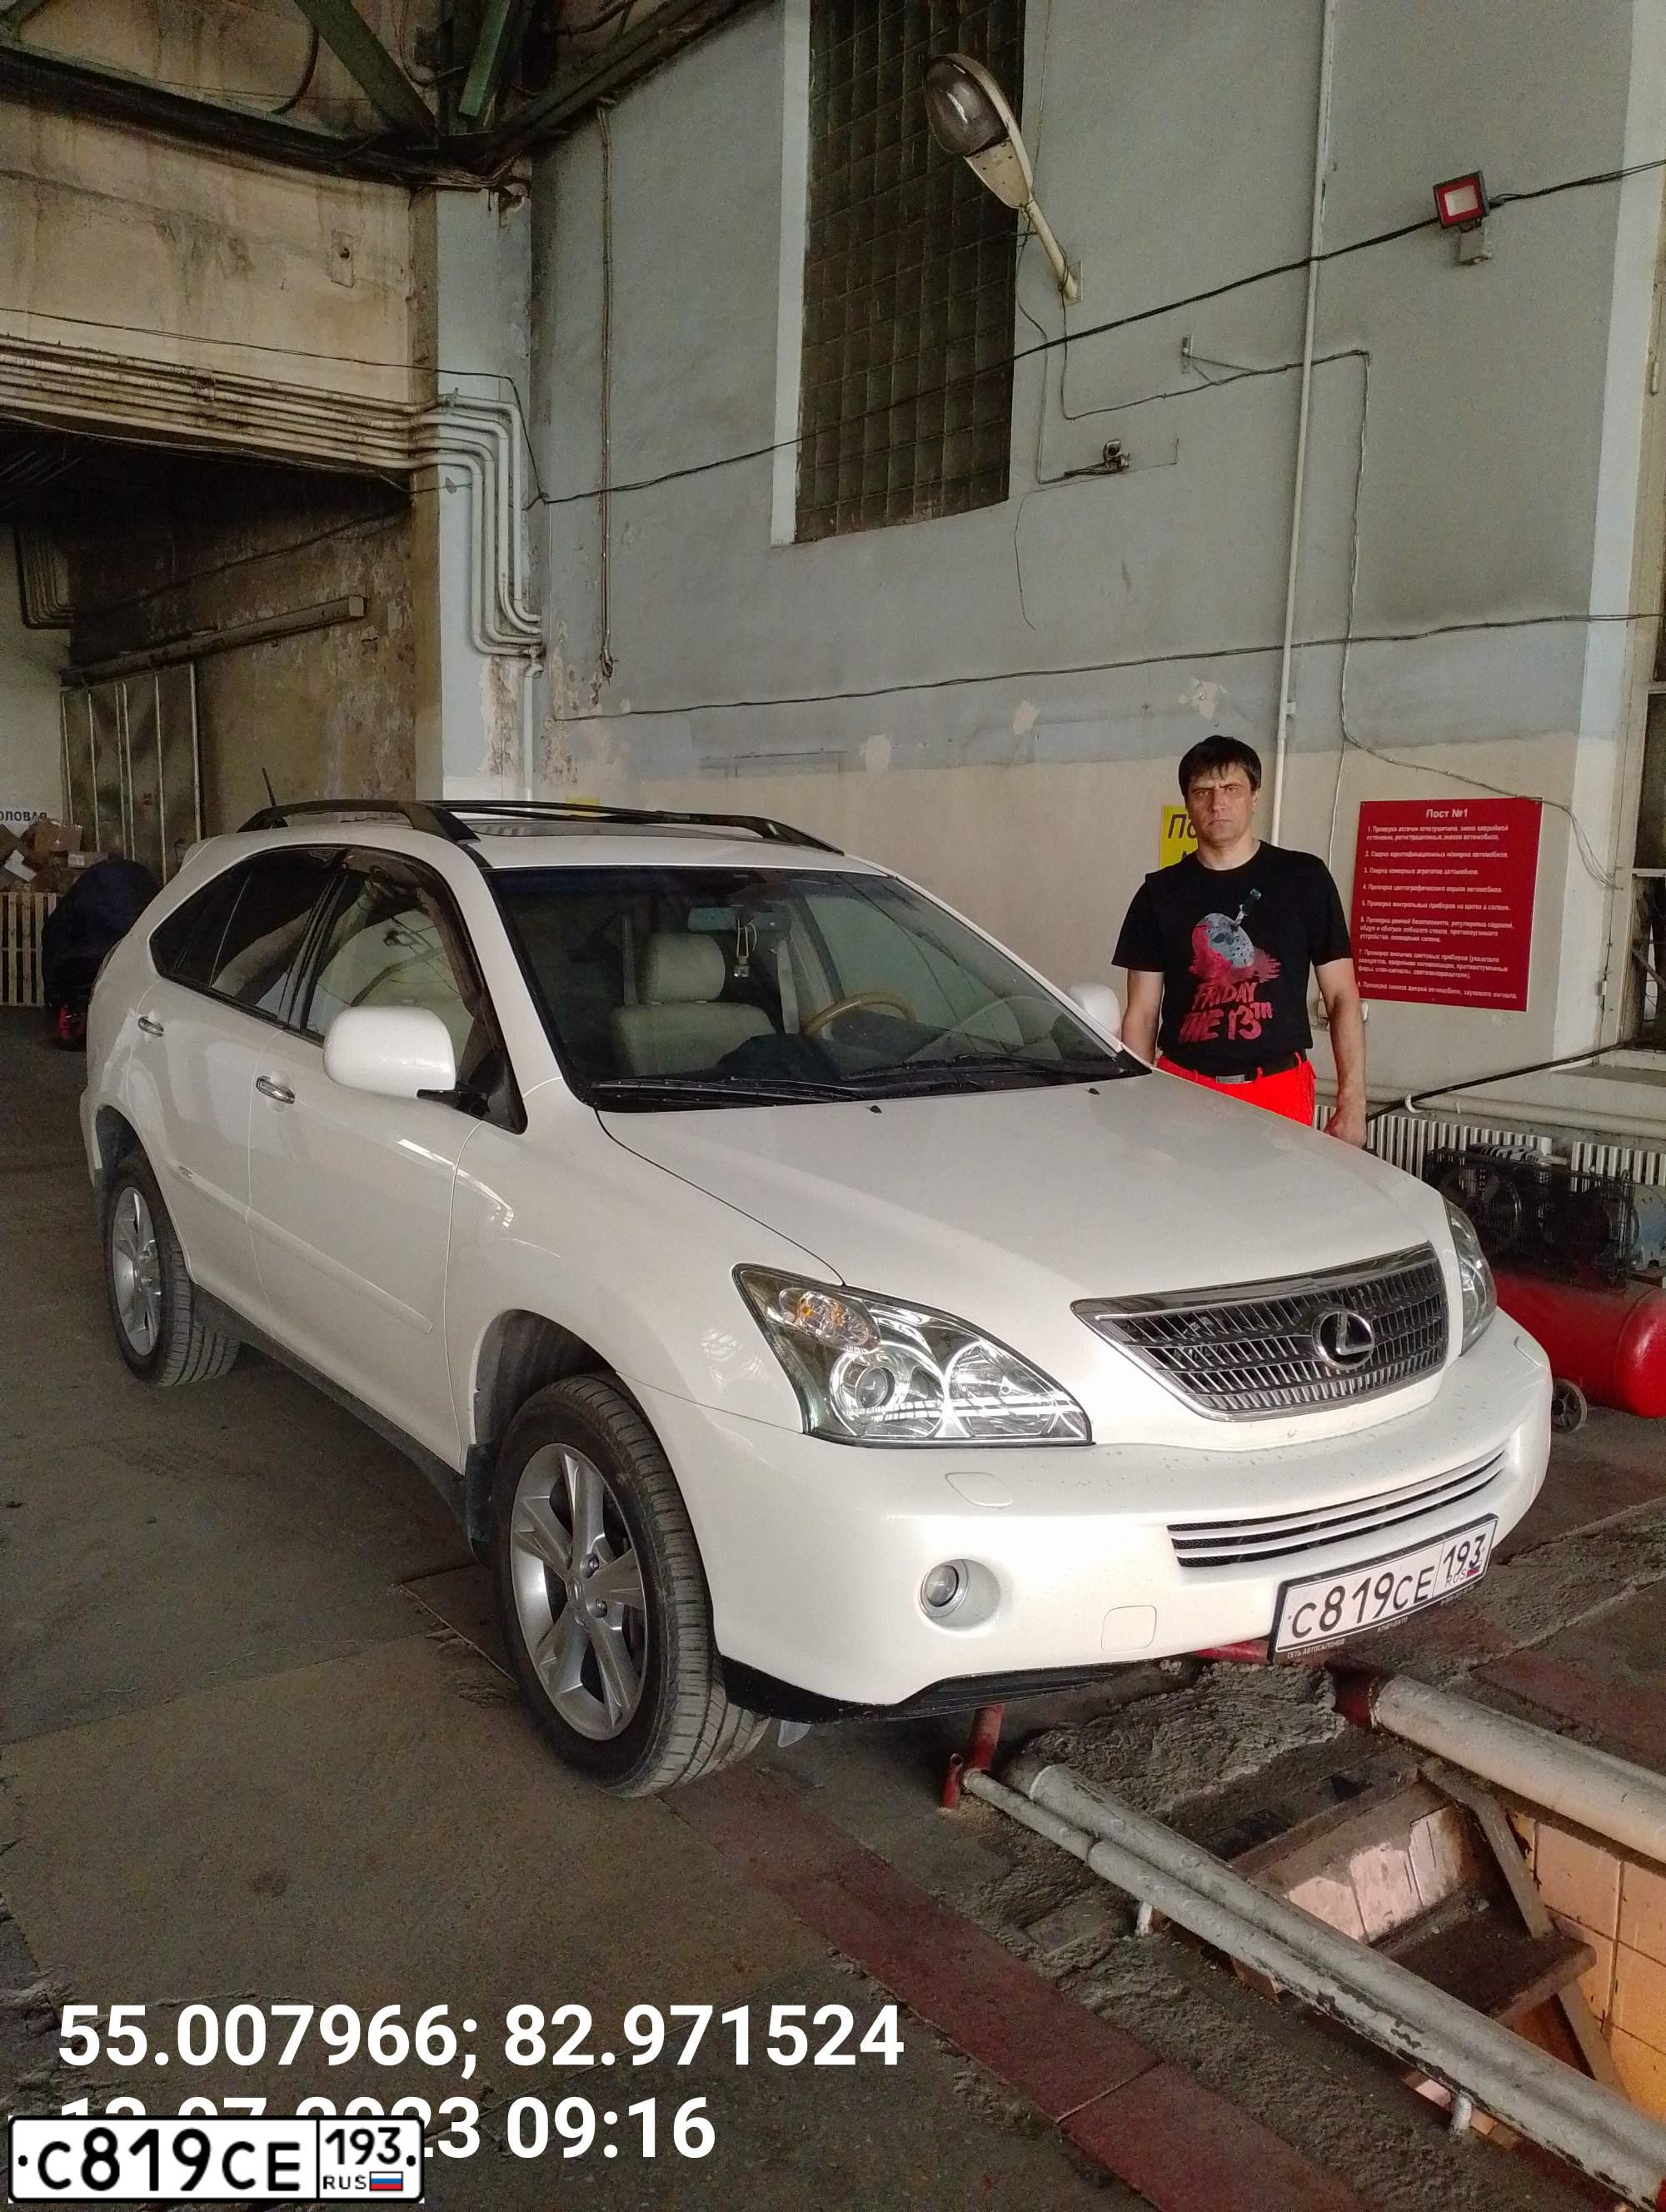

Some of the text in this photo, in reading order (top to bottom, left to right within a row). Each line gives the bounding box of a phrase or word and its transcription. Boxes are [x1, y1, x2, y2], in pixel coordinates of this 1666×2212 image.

[1425, 808, 1449, 818] Пост
[1192, 982, 1258, 1011] FRIDAY
[1179, 1009, 1225, 1044] THE
[1444, 1534, 1486, 1576] 193
[1444, 1568, 1466, 1587] RUS
[1287, 1651, 1301, 1659] СЕТЬ
[1302, 1638, 1344, 1655] АВТОСАЛОНОВ
